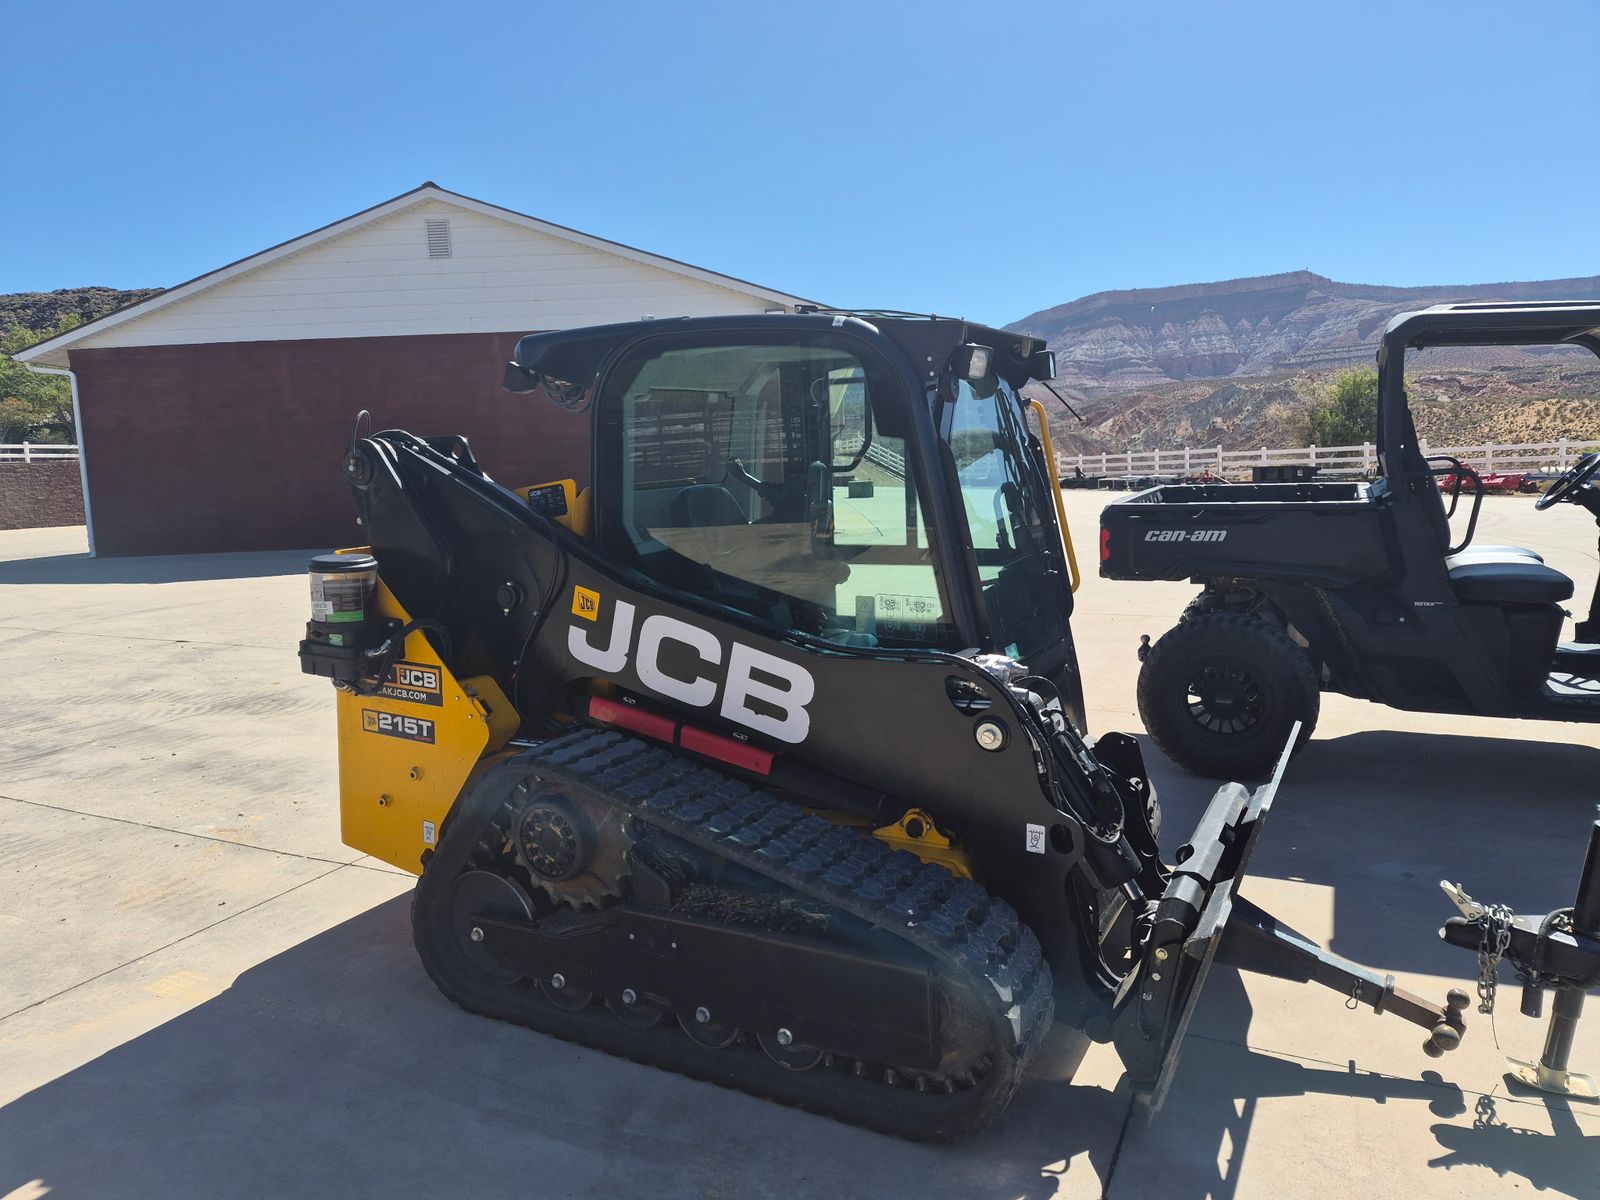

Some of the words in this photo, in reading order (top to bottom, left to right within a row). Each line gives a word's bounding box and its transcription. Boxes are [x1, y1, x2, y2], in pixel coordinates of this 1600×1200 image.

[1144, 530, 1228, 542] can-am
[579, 595, 596, 610] JCB
[400, 670, 436, 688] JCB
[568, 600, 815, 743] JCB
[378, 687, 427, 701] AKJCB.COM
[379, 713, 432, 737] 215T
